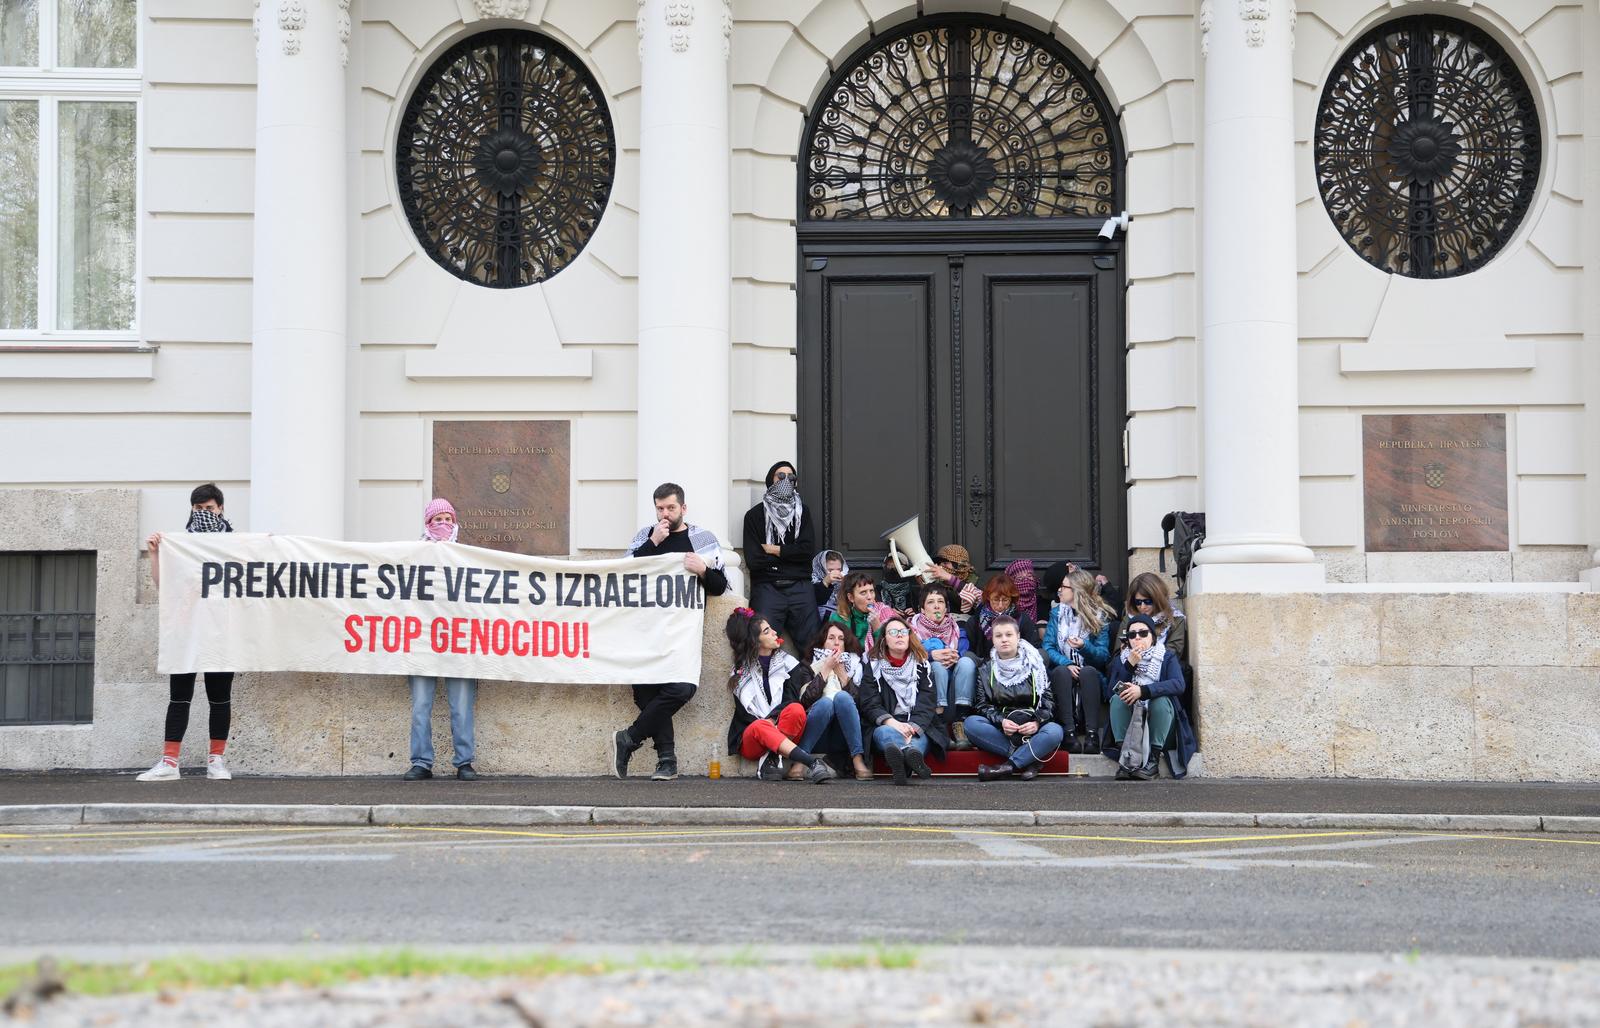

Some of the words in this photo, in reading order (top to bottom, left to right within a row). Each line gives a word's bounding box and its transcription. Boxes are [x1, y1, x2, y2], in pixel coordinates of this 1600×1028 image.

[1379, 440, 1433, 449] REPUBLIKA
[1440, 440, 1489, 449] HRVATSKA
[448, 447, 500, 455] REPUBLIKA
[507, 446, 554, 454] HRVATSKA
[466, 508, 535, 517] MINISTARSTVO
[1400, 504, 1472, 512] MINISTARSTVO
[503, 521, 556, 530] EUROPSKIH
[1379, 517, 1424, 526] VANJSKIH
[1439, 516, 1493, 526] EUROPSKIH
[1413, 530, 1460, 539] POSLOVA
[201, 561, 369, 599] PREKINITE
[376, 563, 435, 601] SVE
[443, 565, 519, 605] VEZE
[528, 570, 547, 606] S
[555, 572, 704, 610] IZRAELOM!
[344, 614, 422, 654] STOP
[430, 616, 590, 659] GENOCIDU!
